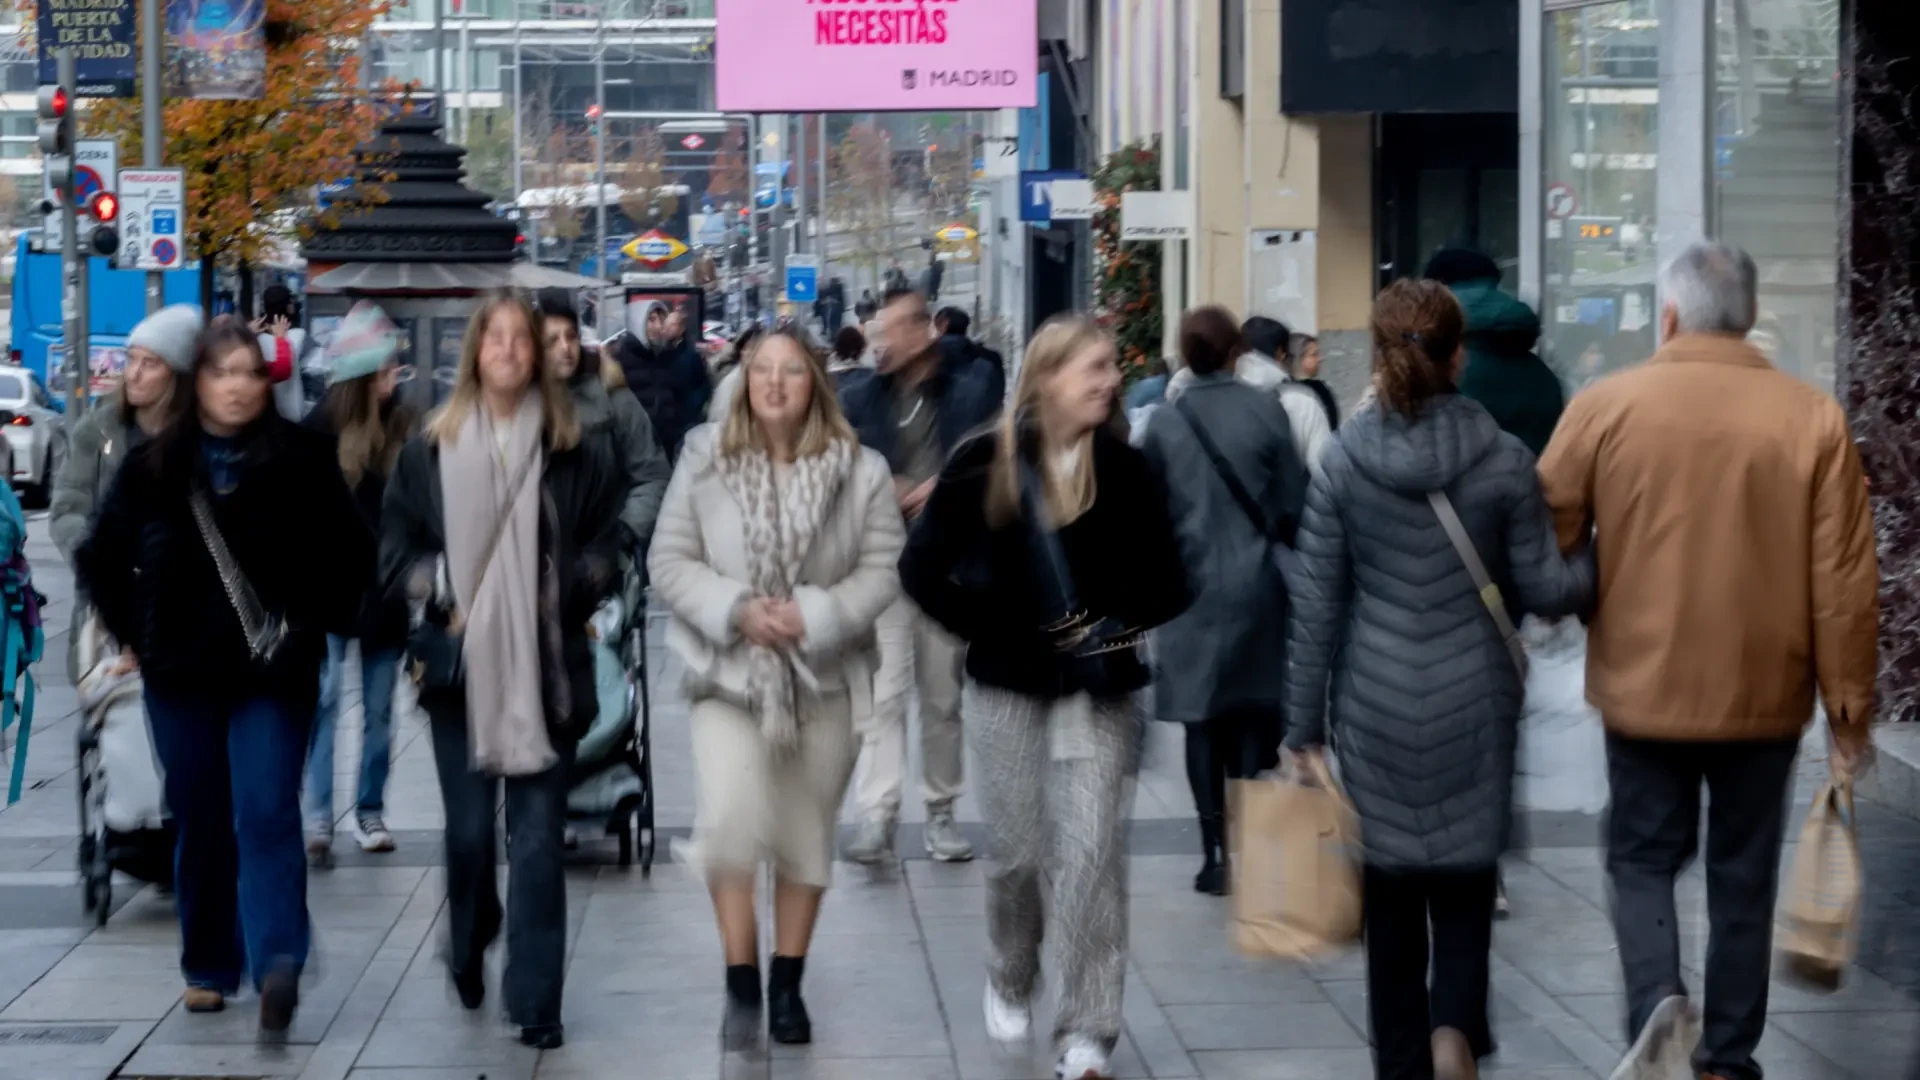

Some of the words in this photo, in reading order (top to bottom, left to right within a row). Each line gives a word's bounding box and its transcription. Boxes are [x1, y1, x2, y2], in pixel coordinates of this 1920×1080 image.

[52, 11, 121, 27] PUERTA
[815, 10, 947, 44] NECESITAS
[58, 28, 85, 43] DE
[87, 27, 113, 42] LA
[46, 44, 130, 60] NVIDAD
[930, 69, 1018, 87] MADRID
